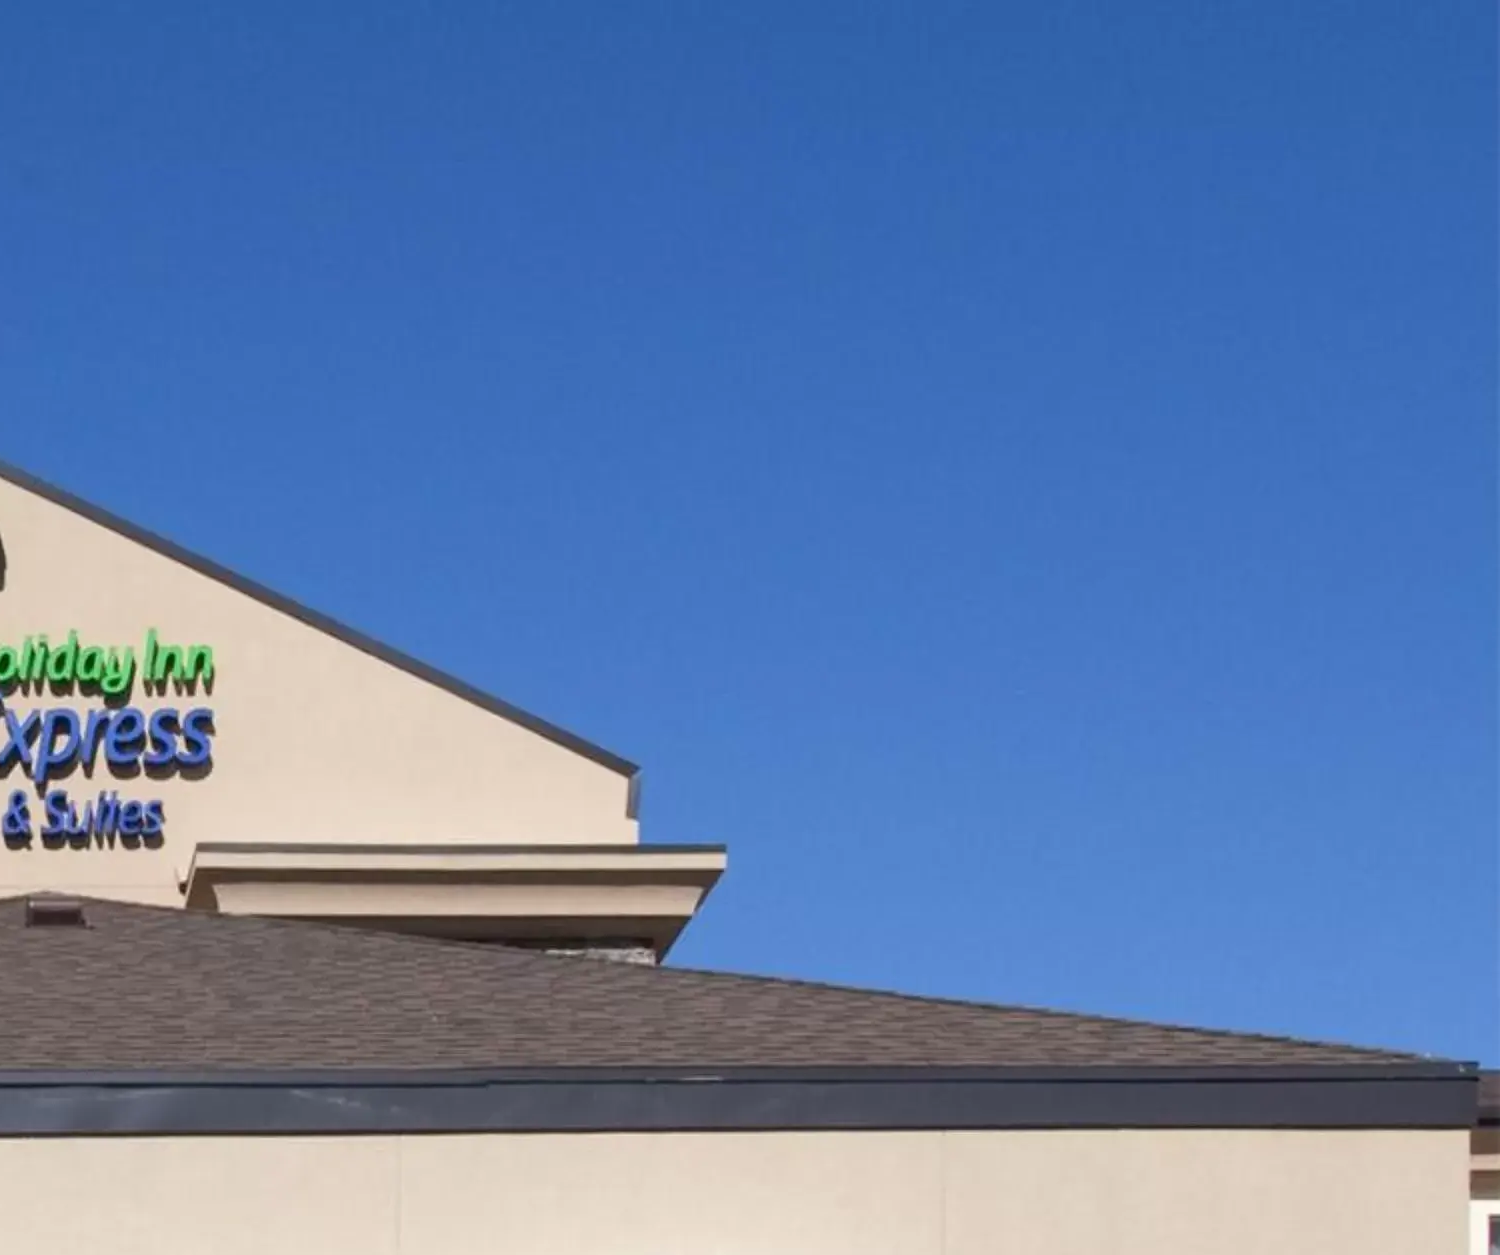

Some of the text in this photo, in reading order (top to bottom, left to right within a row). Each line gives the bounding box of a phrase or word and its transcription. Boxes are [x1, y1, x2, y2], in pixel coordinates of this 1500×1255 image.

[142, 628, 213, 684] Inn
[2, 789, 165, 837] & Suites
